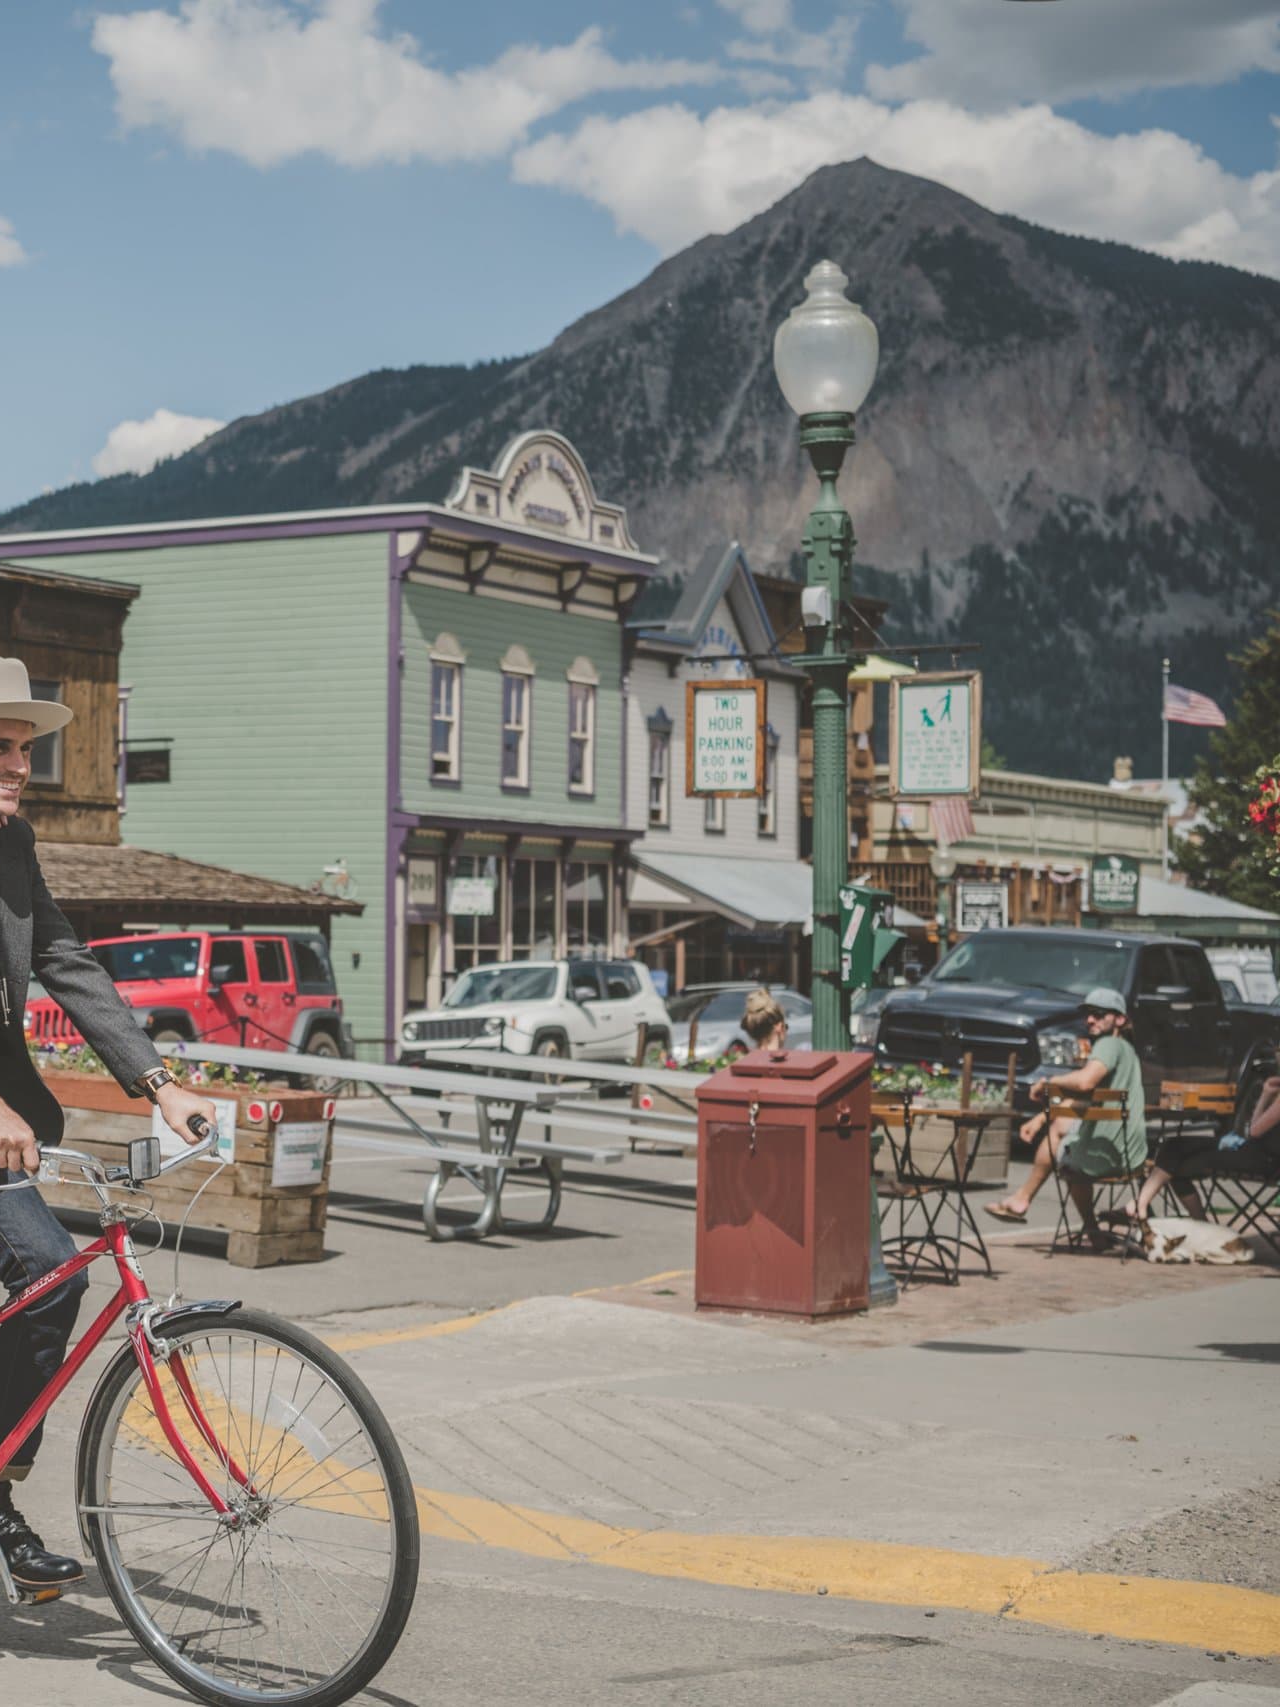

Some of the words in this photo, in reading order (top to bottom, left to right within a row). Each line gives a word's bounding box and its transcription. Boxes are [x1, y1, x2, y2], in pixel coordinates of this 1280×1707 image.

[714, 697, 738, 710] TWO
[708, 717, 742, 731] HOUR
[699, 737, 753, 751] PARKING
[701, 756, 725, 766] 8:00
[704, 771, 728, 782] 5:00
[734, 771, 748, 781] PM
[1094, 870, 1138, 887] ELDO
